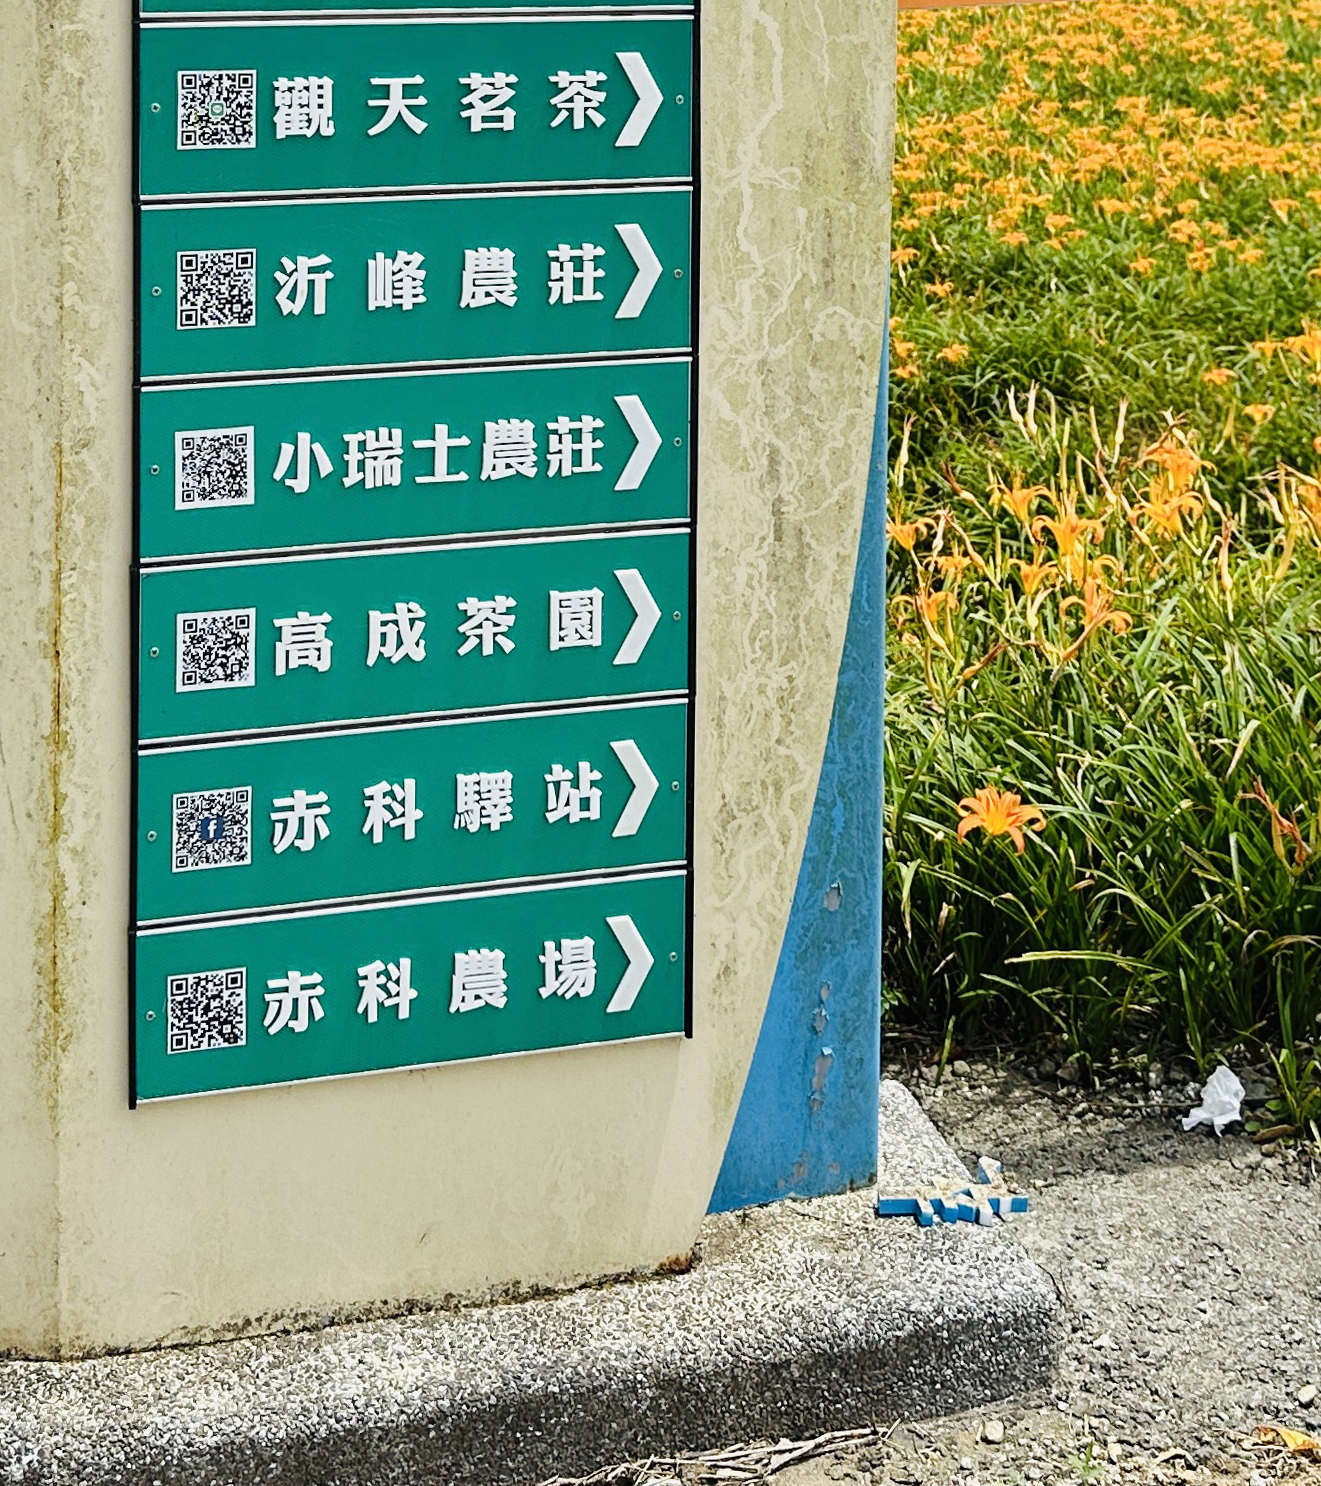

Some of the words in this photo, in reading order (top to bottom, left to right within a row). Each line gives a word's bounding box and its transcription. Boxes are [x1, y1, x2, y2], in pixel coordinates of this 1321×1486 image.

[272, 70, 608, 140] 觀天茗茶
[273, 242, 606, 316] 沂峰農莊
[273, 414, 605, 493] 小瑞士農莊
[273, 586, 604, 676] 高成茶園
[270, 761, 603, 854] 赤科驛站
[263, 935, 597, 1035] 赤科農場
